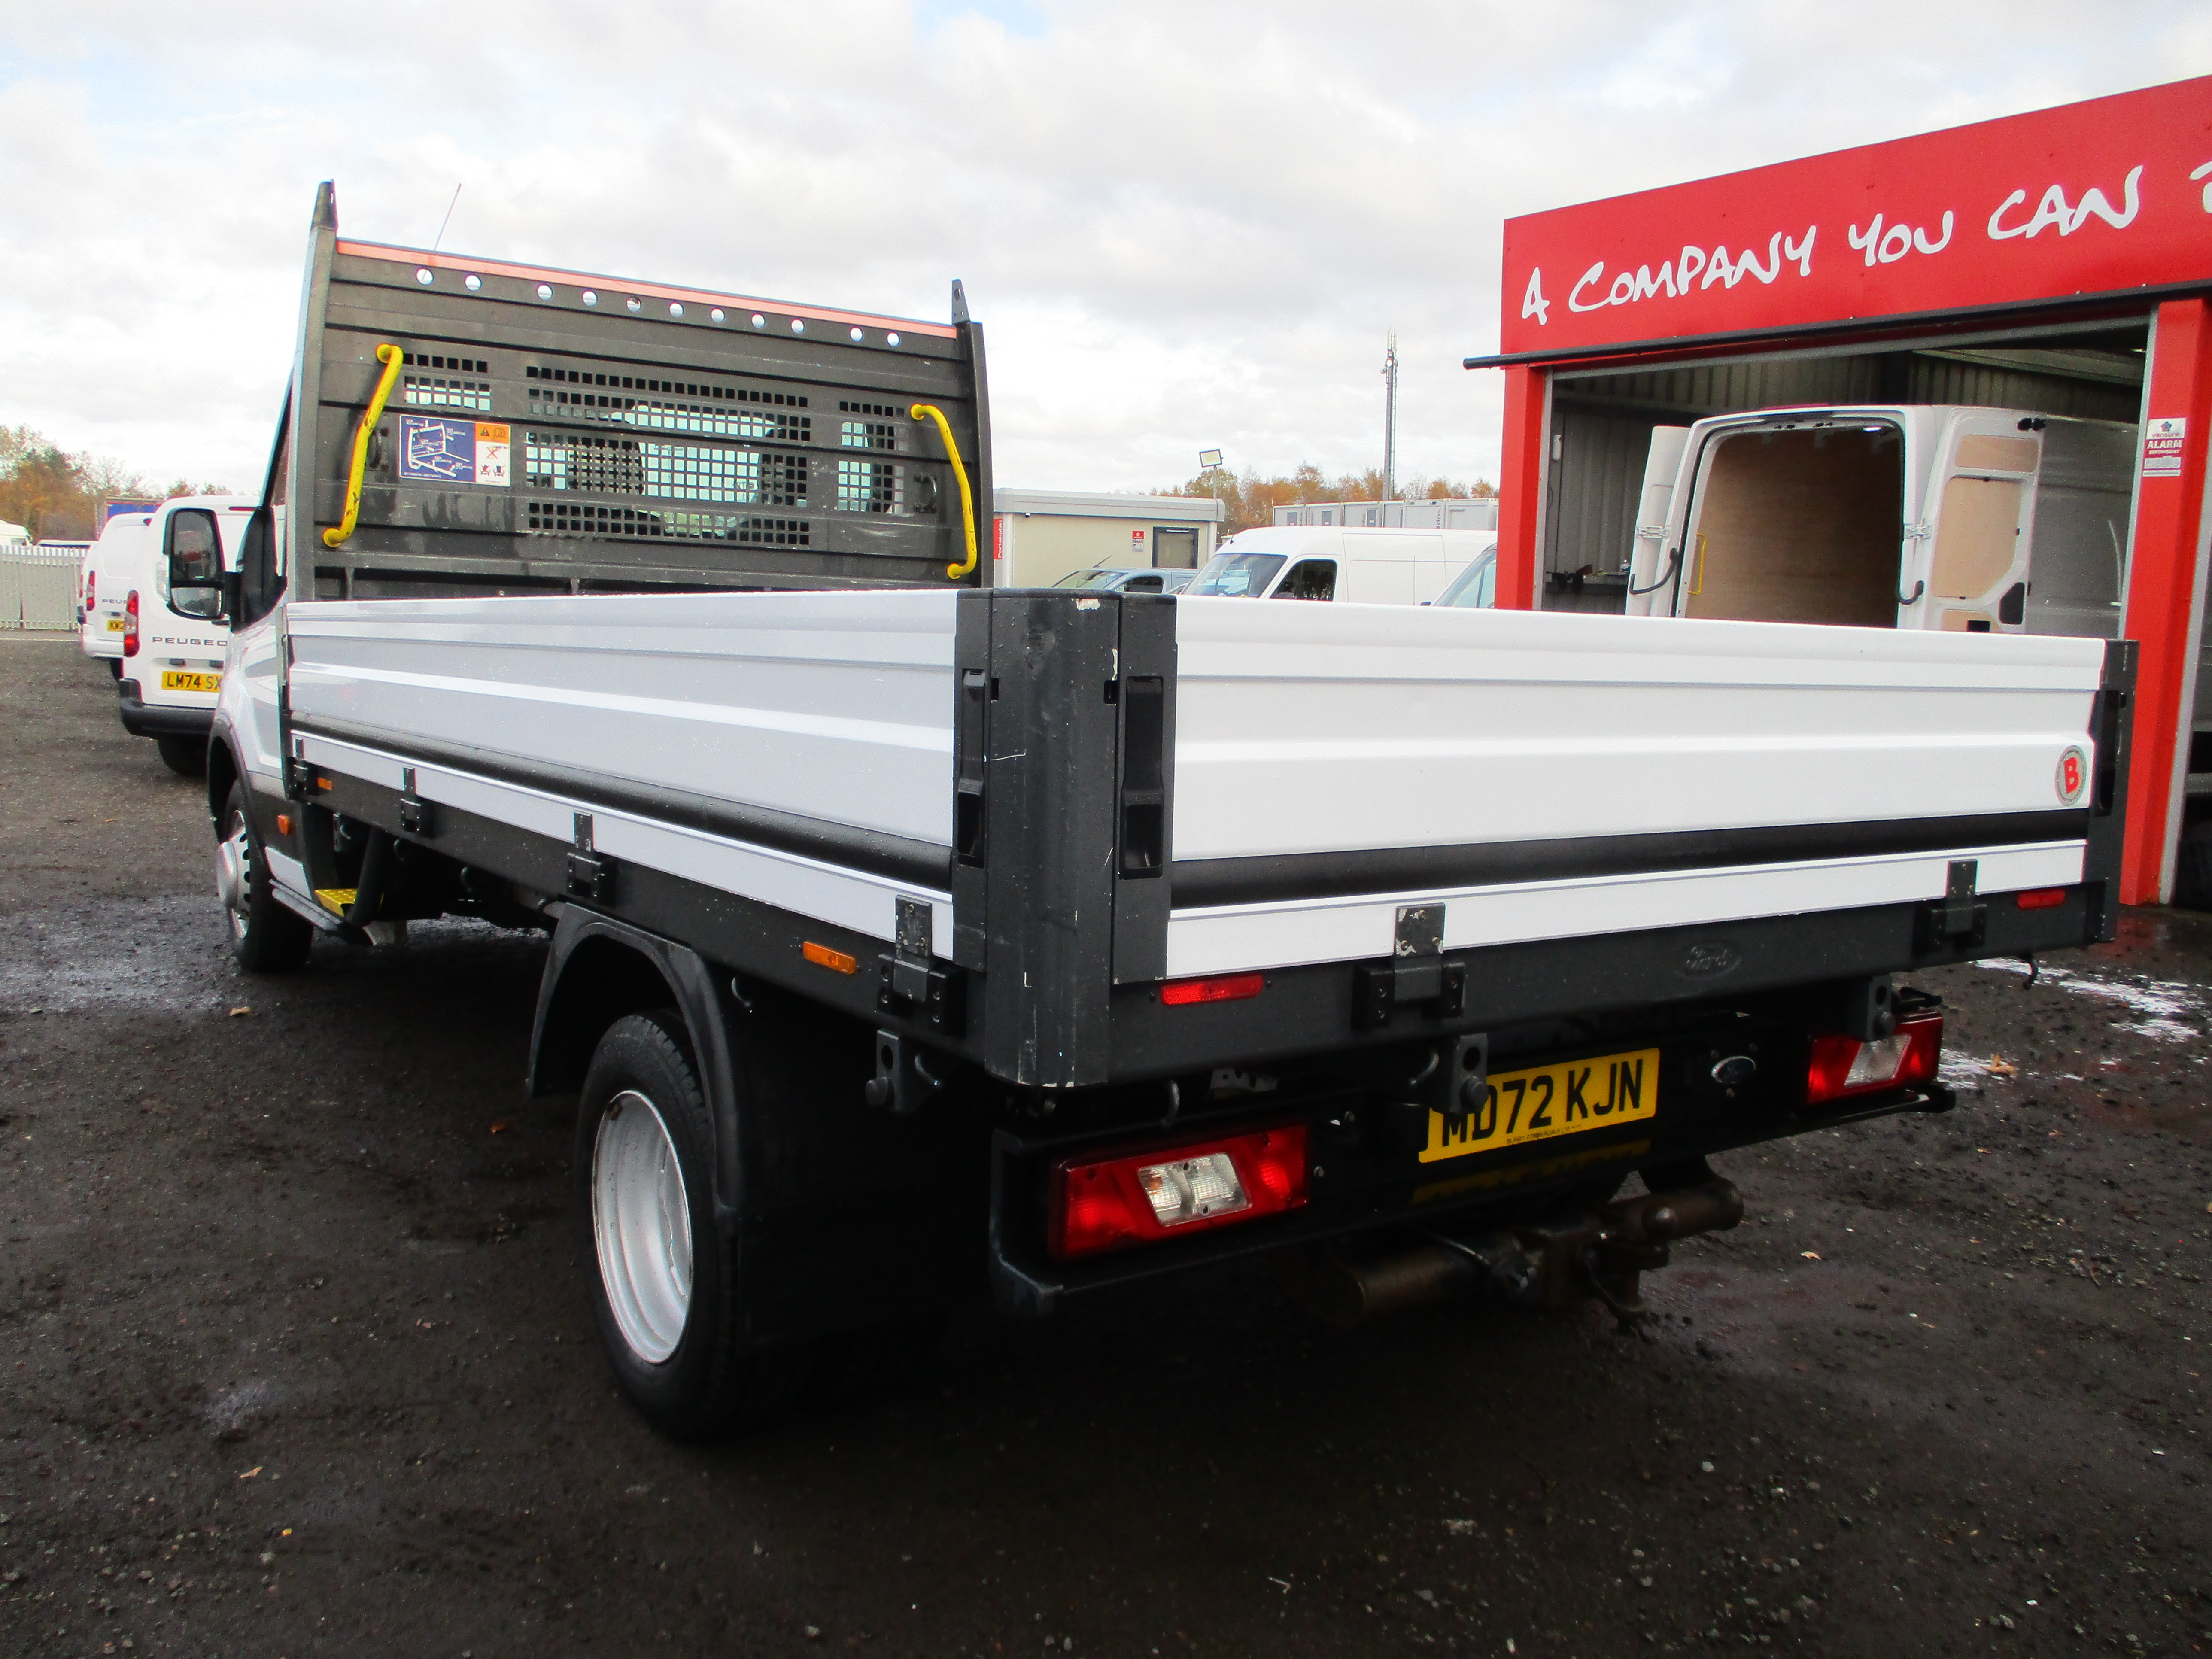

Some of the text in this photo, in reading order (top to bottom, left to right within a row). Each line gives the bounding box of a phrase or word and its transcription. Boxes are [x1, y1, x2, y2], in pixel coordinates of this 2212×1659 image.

[1521, 267, 1550, 325] A
[1568, 225, 1817, 313] COMPANY
[1847, 210, 1954, 267] YOU
[1987, 164, 2144, 240] CAN
[2147, 440, 2182, 449] ALARM
[167, 673, 201, 688] LM74
[2064, 757, 2079, 794] B
[1566, 1058, 1644, 1122] KJN
